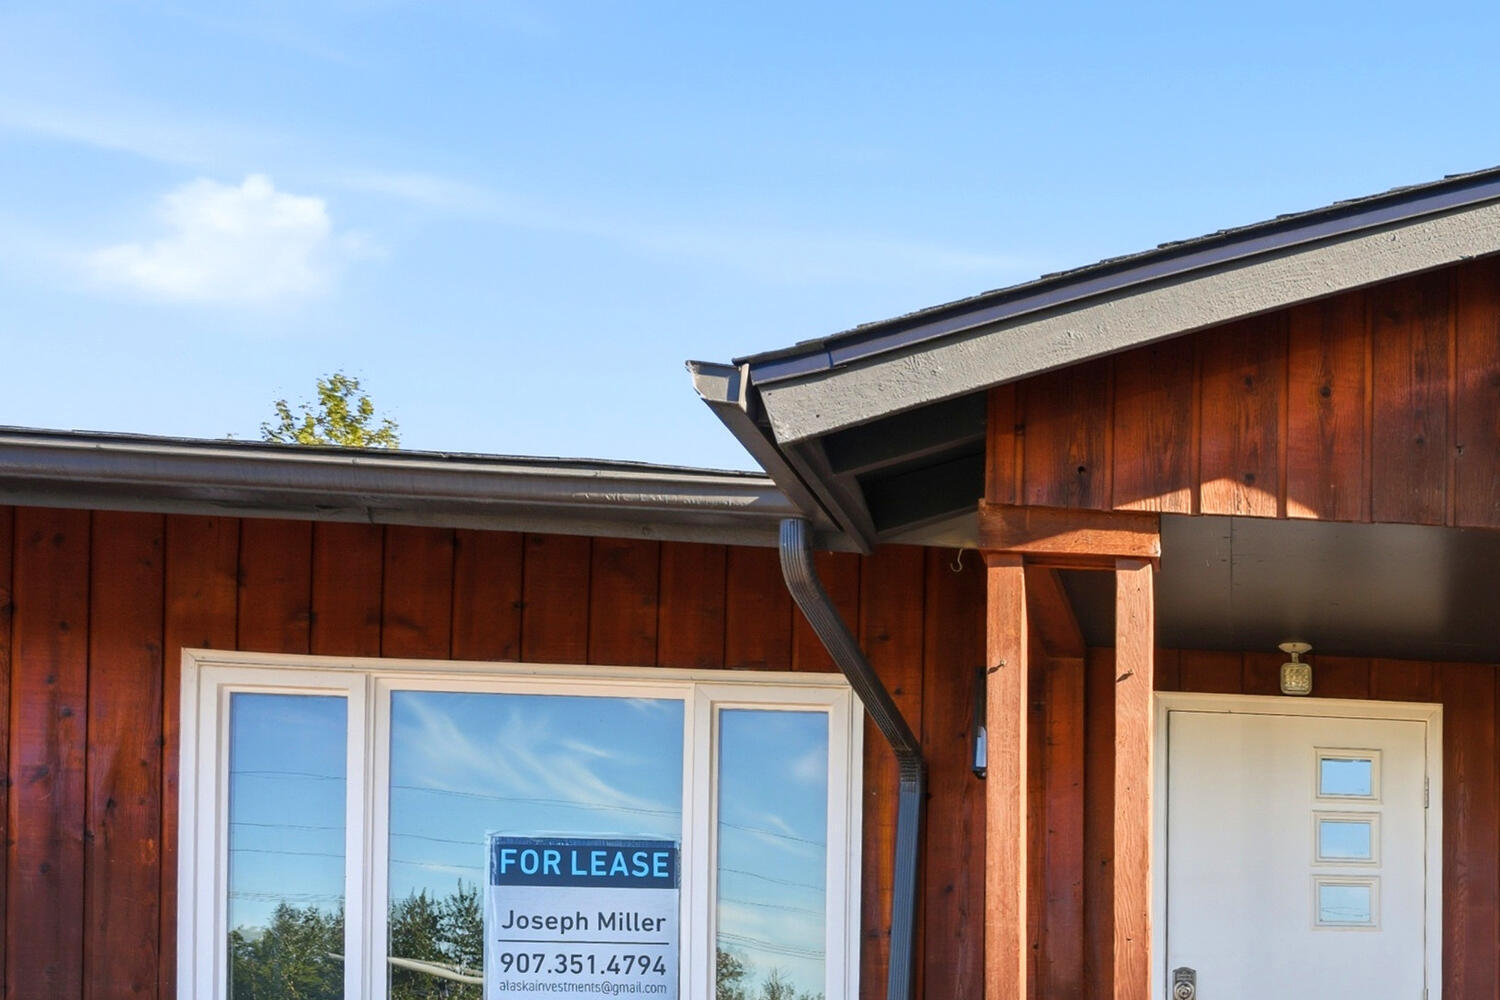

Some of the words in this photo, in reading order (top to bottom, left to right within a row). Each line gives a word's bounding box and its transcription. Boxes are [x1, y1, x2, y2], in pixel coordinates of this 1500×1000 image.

[500, 849, 562, 876] FOR
[571, 850, 670, 878] LEASE
[501, 909, 590, 935] Joseph
[597, 911, 667, 933] Miller
[500, 952, 667, 976] 907.351.4794
[499, 979, 668, 996] alaskainvestments@gmail.com
